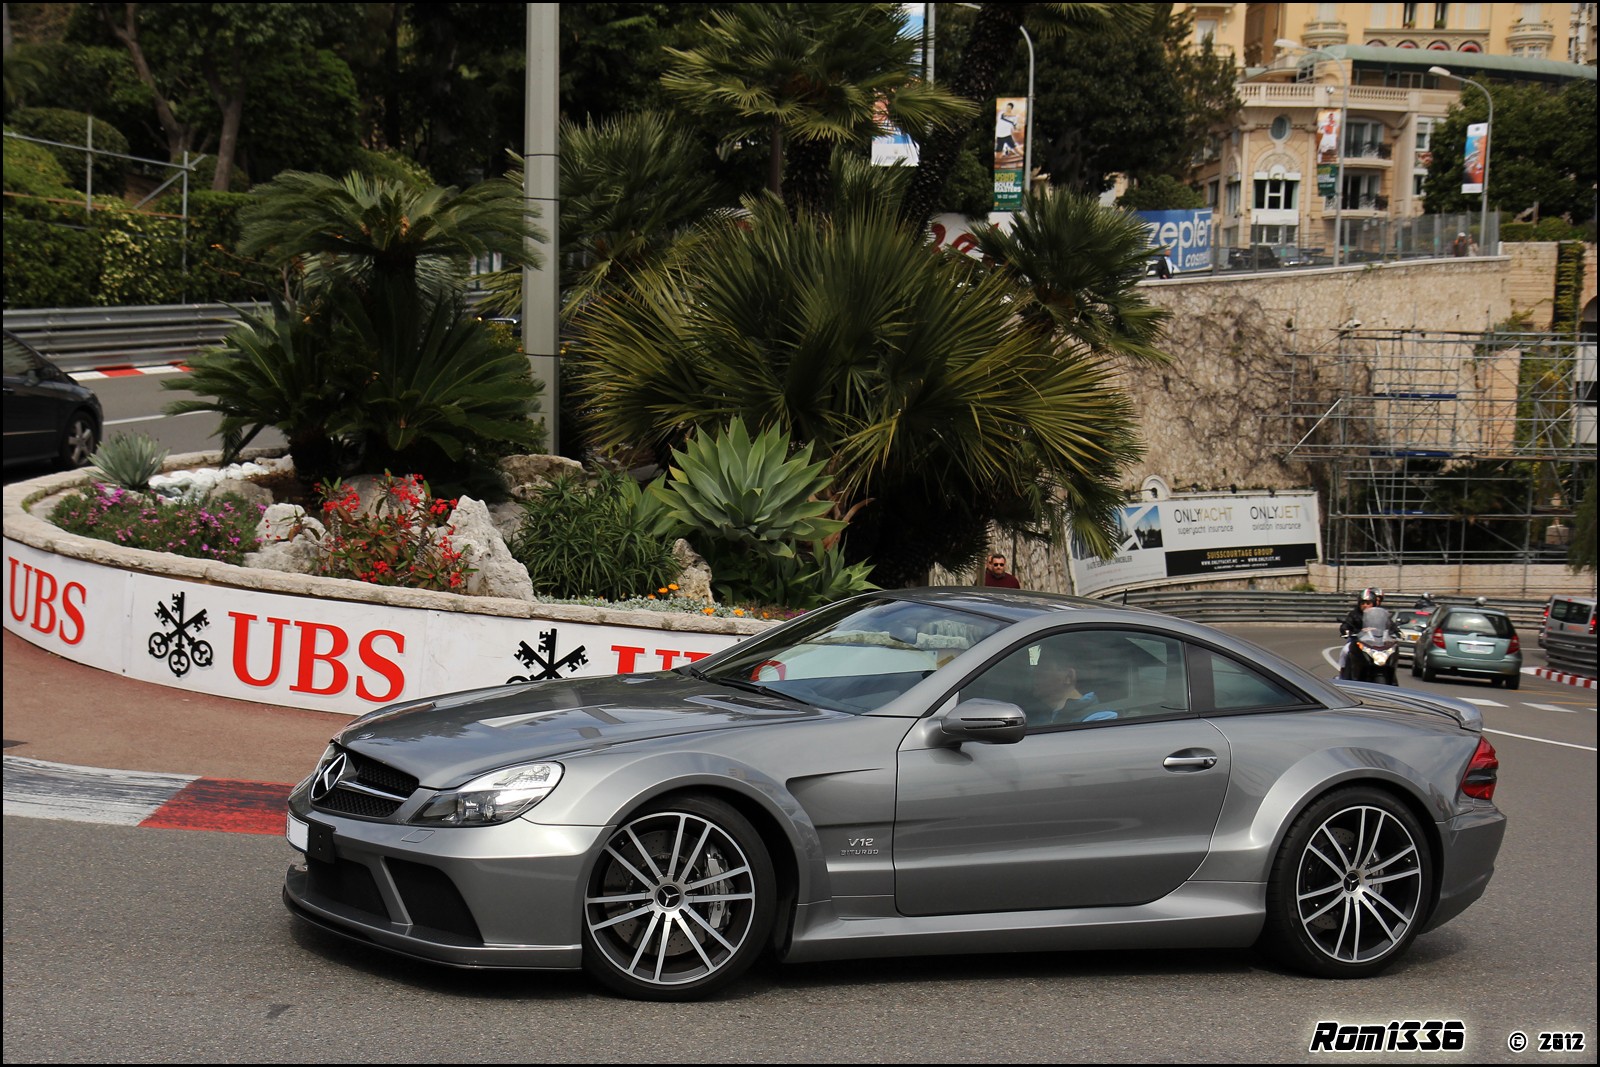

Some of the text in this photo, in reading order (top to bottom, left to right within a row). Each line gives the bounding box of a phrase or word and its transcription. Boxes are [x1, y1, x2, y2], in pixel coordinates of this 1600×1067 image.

[1145, 210, 1212, 267] zepter
[1249, 505, 1300, 520] ONLYJET
[1178, 524, 1234, 535] superyacht insurance
[1252, 522, 1301, 531] aviation insurance
[1206, 547, 1274, 559] SUISSCOURTAGE GROUP
[8, 556, 88, 645] UBS
[228, 611, 405, 703] UBS
[848, 837, 874, 847] V12
[840, 849, 879, 857] BITURBO
